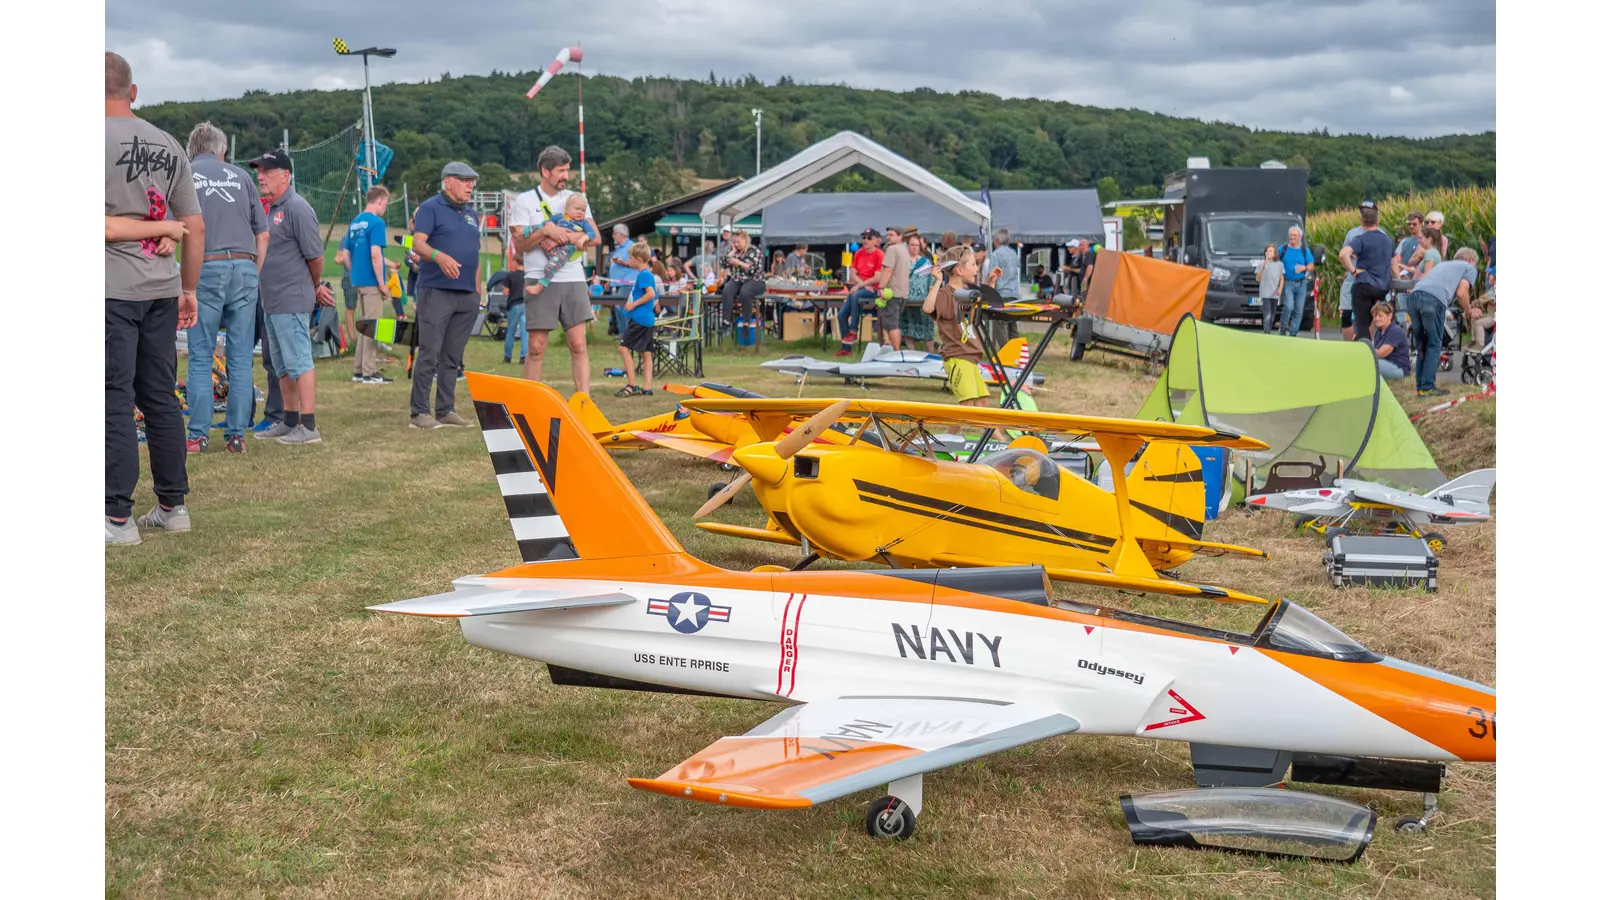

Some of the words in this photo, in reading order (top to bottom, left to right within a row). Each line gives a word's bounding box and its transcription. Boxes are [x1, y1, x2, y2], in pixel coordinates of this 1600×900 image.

[209, 179, 241, 190] Rodenberg
[513, 413, 561, 496] V
[634, 653, 655, 664] USS
[659, 655, 687, 668] ENTE
[690, 659, 730, 672] RPRISE
[784, 629, 793, 672] DANGER
[891, 622, 1002, 668] NAVY
[1077, 659, 1144, 685] Odyssey
[800, 719, 892, 760] NAVY
